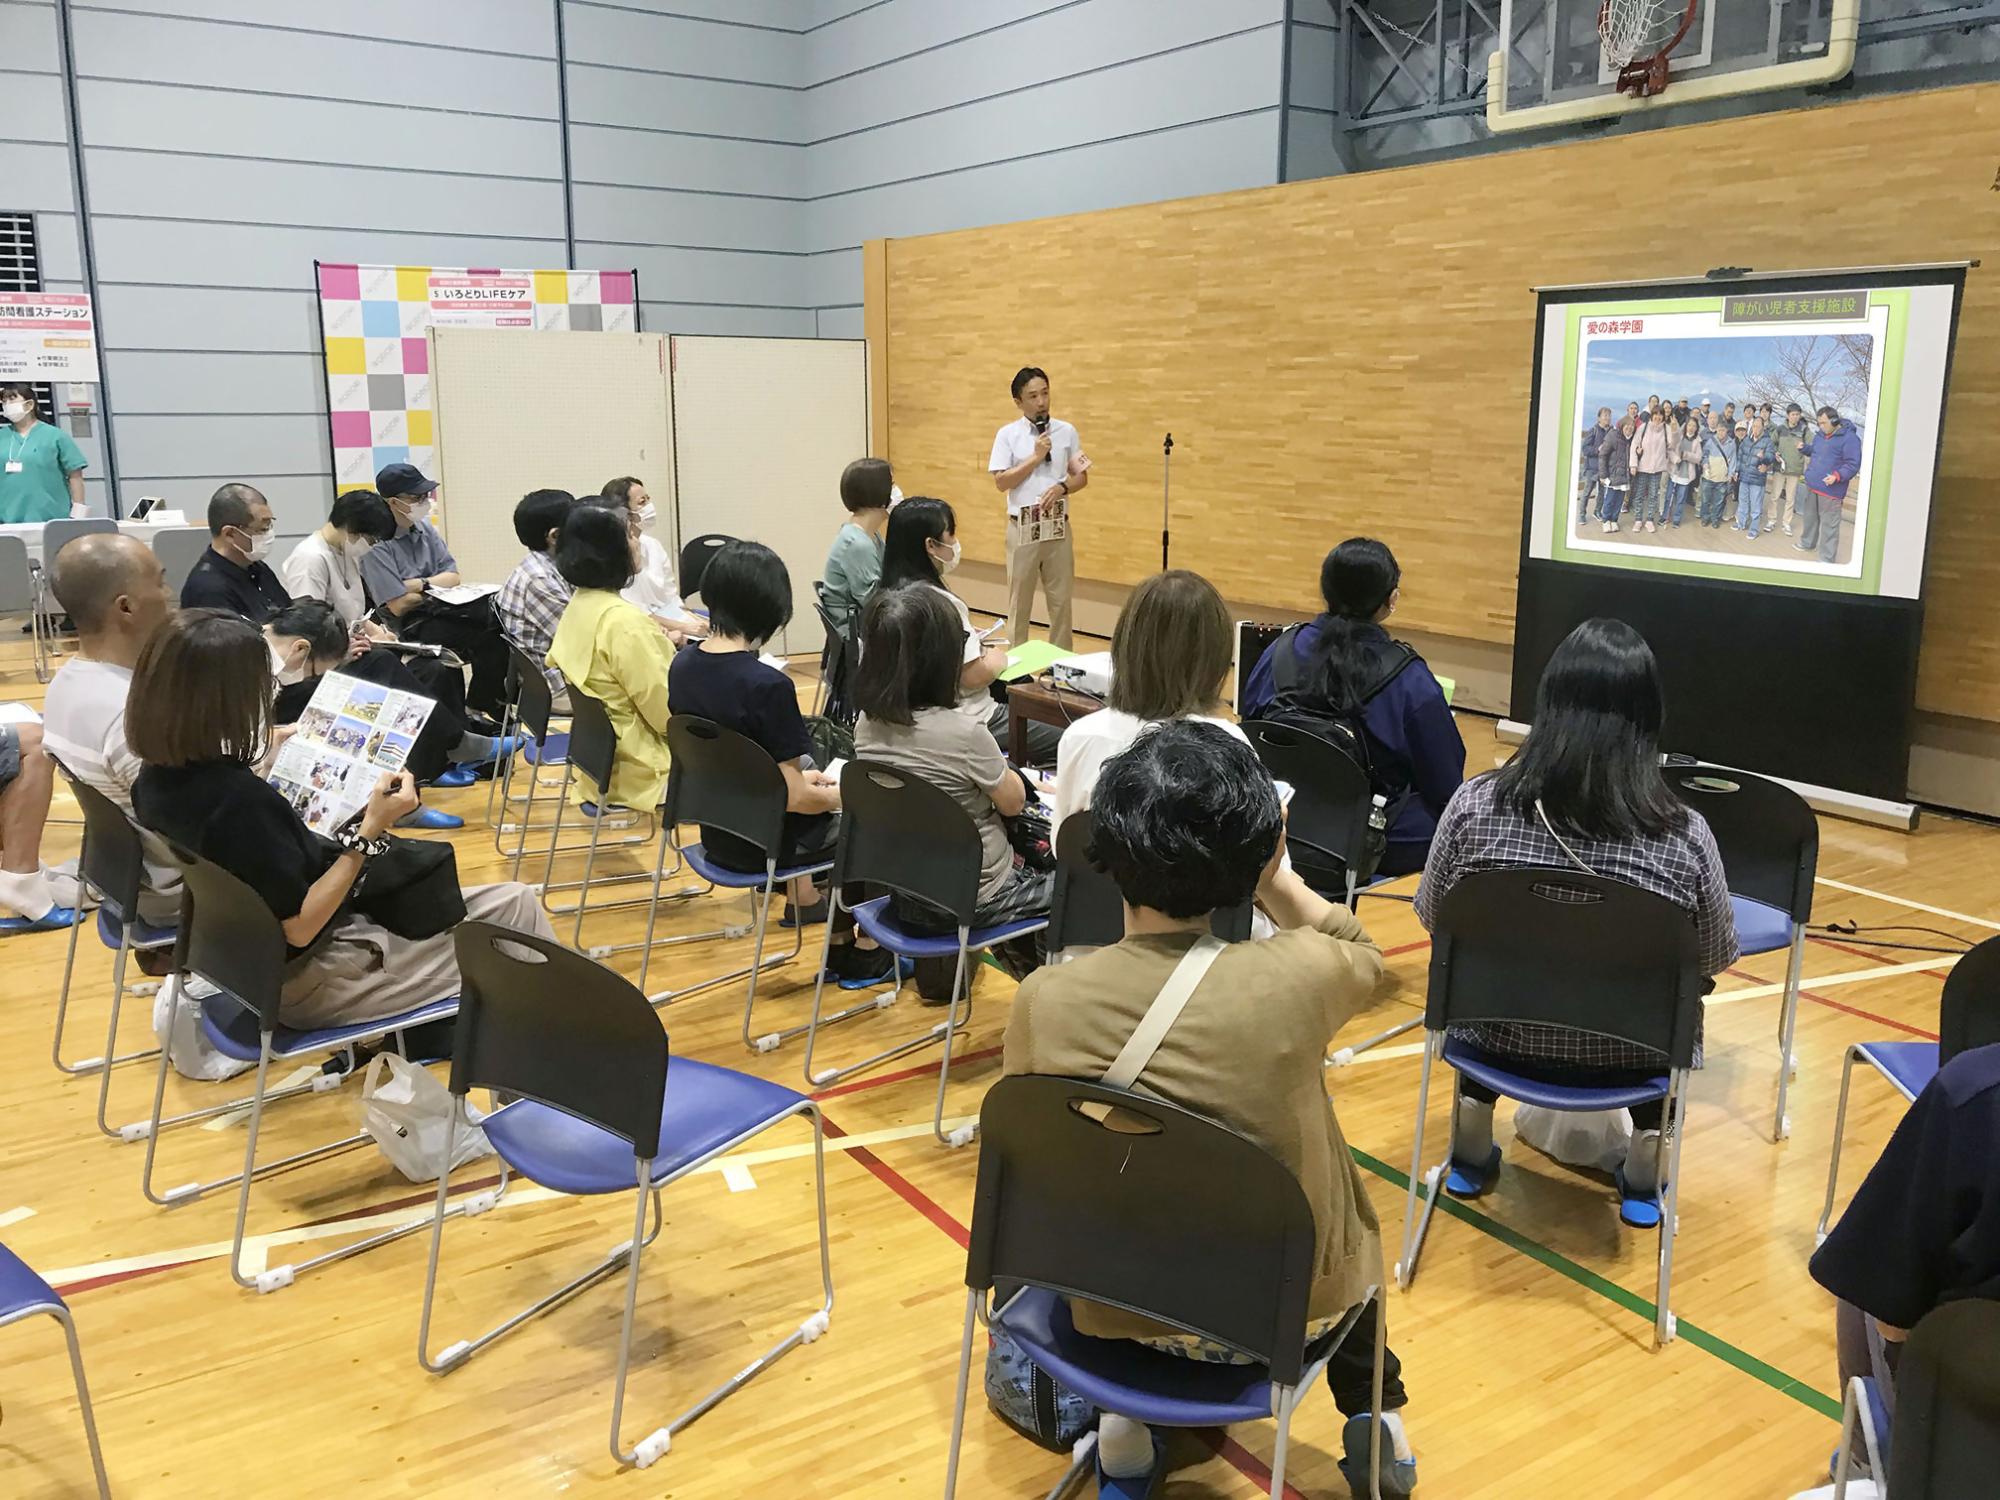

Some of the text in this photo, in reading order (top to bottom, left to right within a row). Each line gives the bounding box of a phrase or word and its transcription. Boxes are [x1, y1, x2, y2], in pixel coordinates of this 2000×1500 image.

[444, 289, 526, 299] いろどりLIFEケア
[1732, 298, 1857, 316] 障がい児者支援施設
[1586, 319, 1644, 335] 愛の森学園
